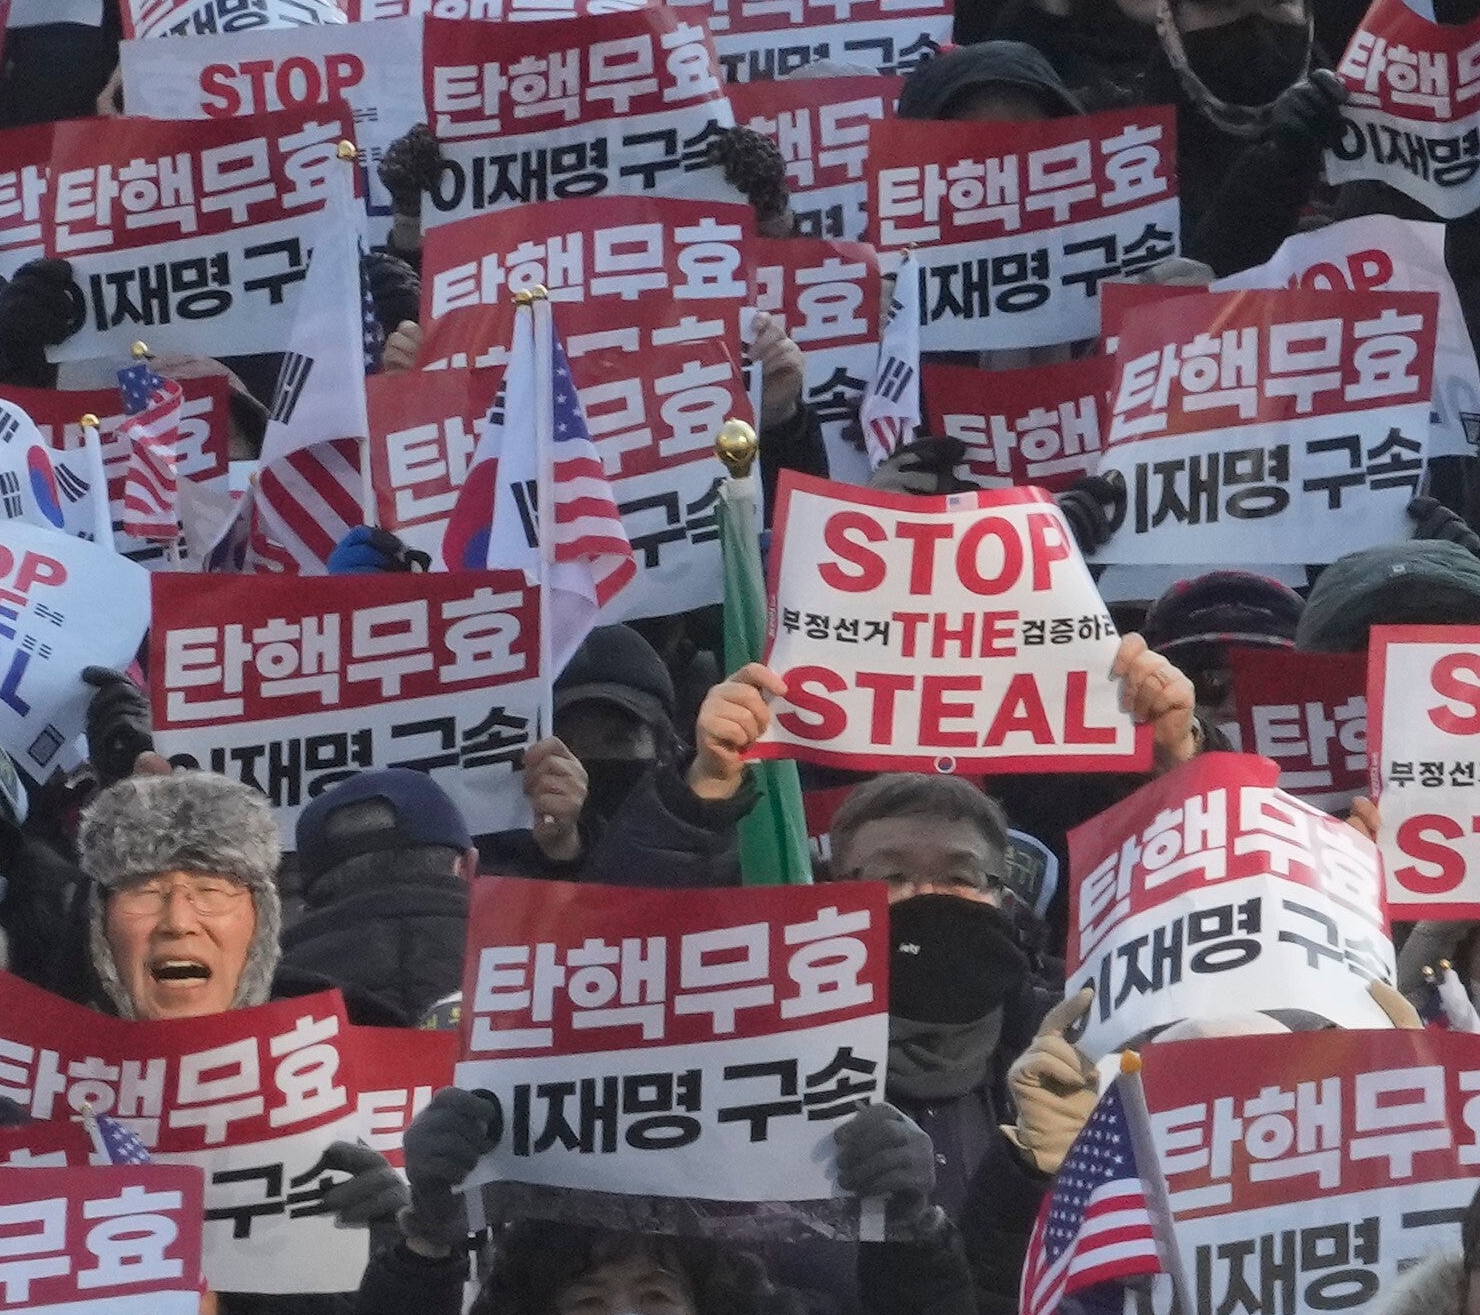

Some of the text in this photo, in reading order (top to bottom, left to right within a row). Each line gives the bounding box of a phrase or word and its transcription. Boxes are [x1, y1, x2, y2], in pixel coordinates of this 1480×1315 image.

[879, 125, 1176, 246] 탄핵무효
[1117, 309, 1422, 435] 탄핵무효
[820, 510, 1070, 594] STOP
[166, 586, 536, 727] 탄핵무효
[781, 607, 1019, 659] 부정선거 THE
[776, 667, 1119, 750] STEAL
[473, 905, 873, 1061] 탄핵무효
